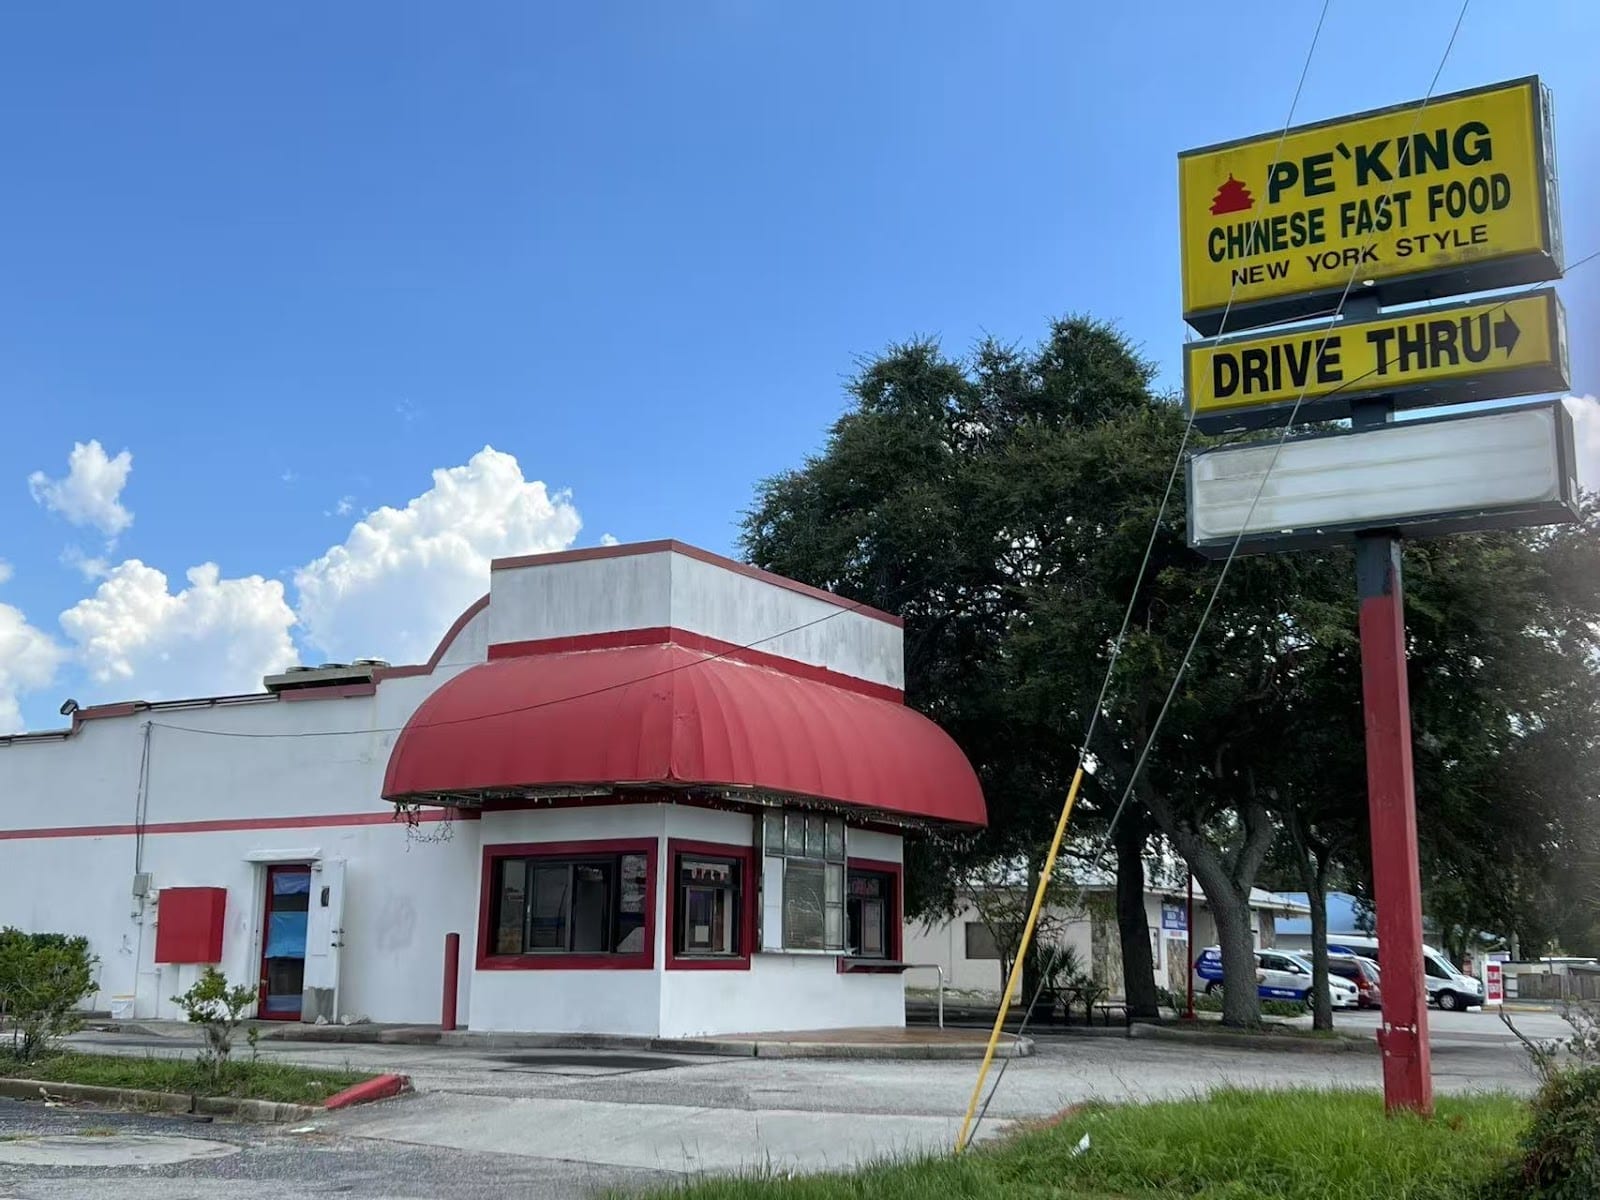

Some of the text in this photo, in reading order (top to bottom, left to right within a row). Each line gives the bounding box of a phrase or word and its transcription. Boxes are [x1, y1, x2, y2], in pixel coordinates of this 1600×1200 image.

[1208, 172, 1511, 263] CHINESE FAST FOOD
[1232, 224, 1488, 286] NEW YORK STYLE
[1213, 313, 1491, 398] DRIVE THRU
